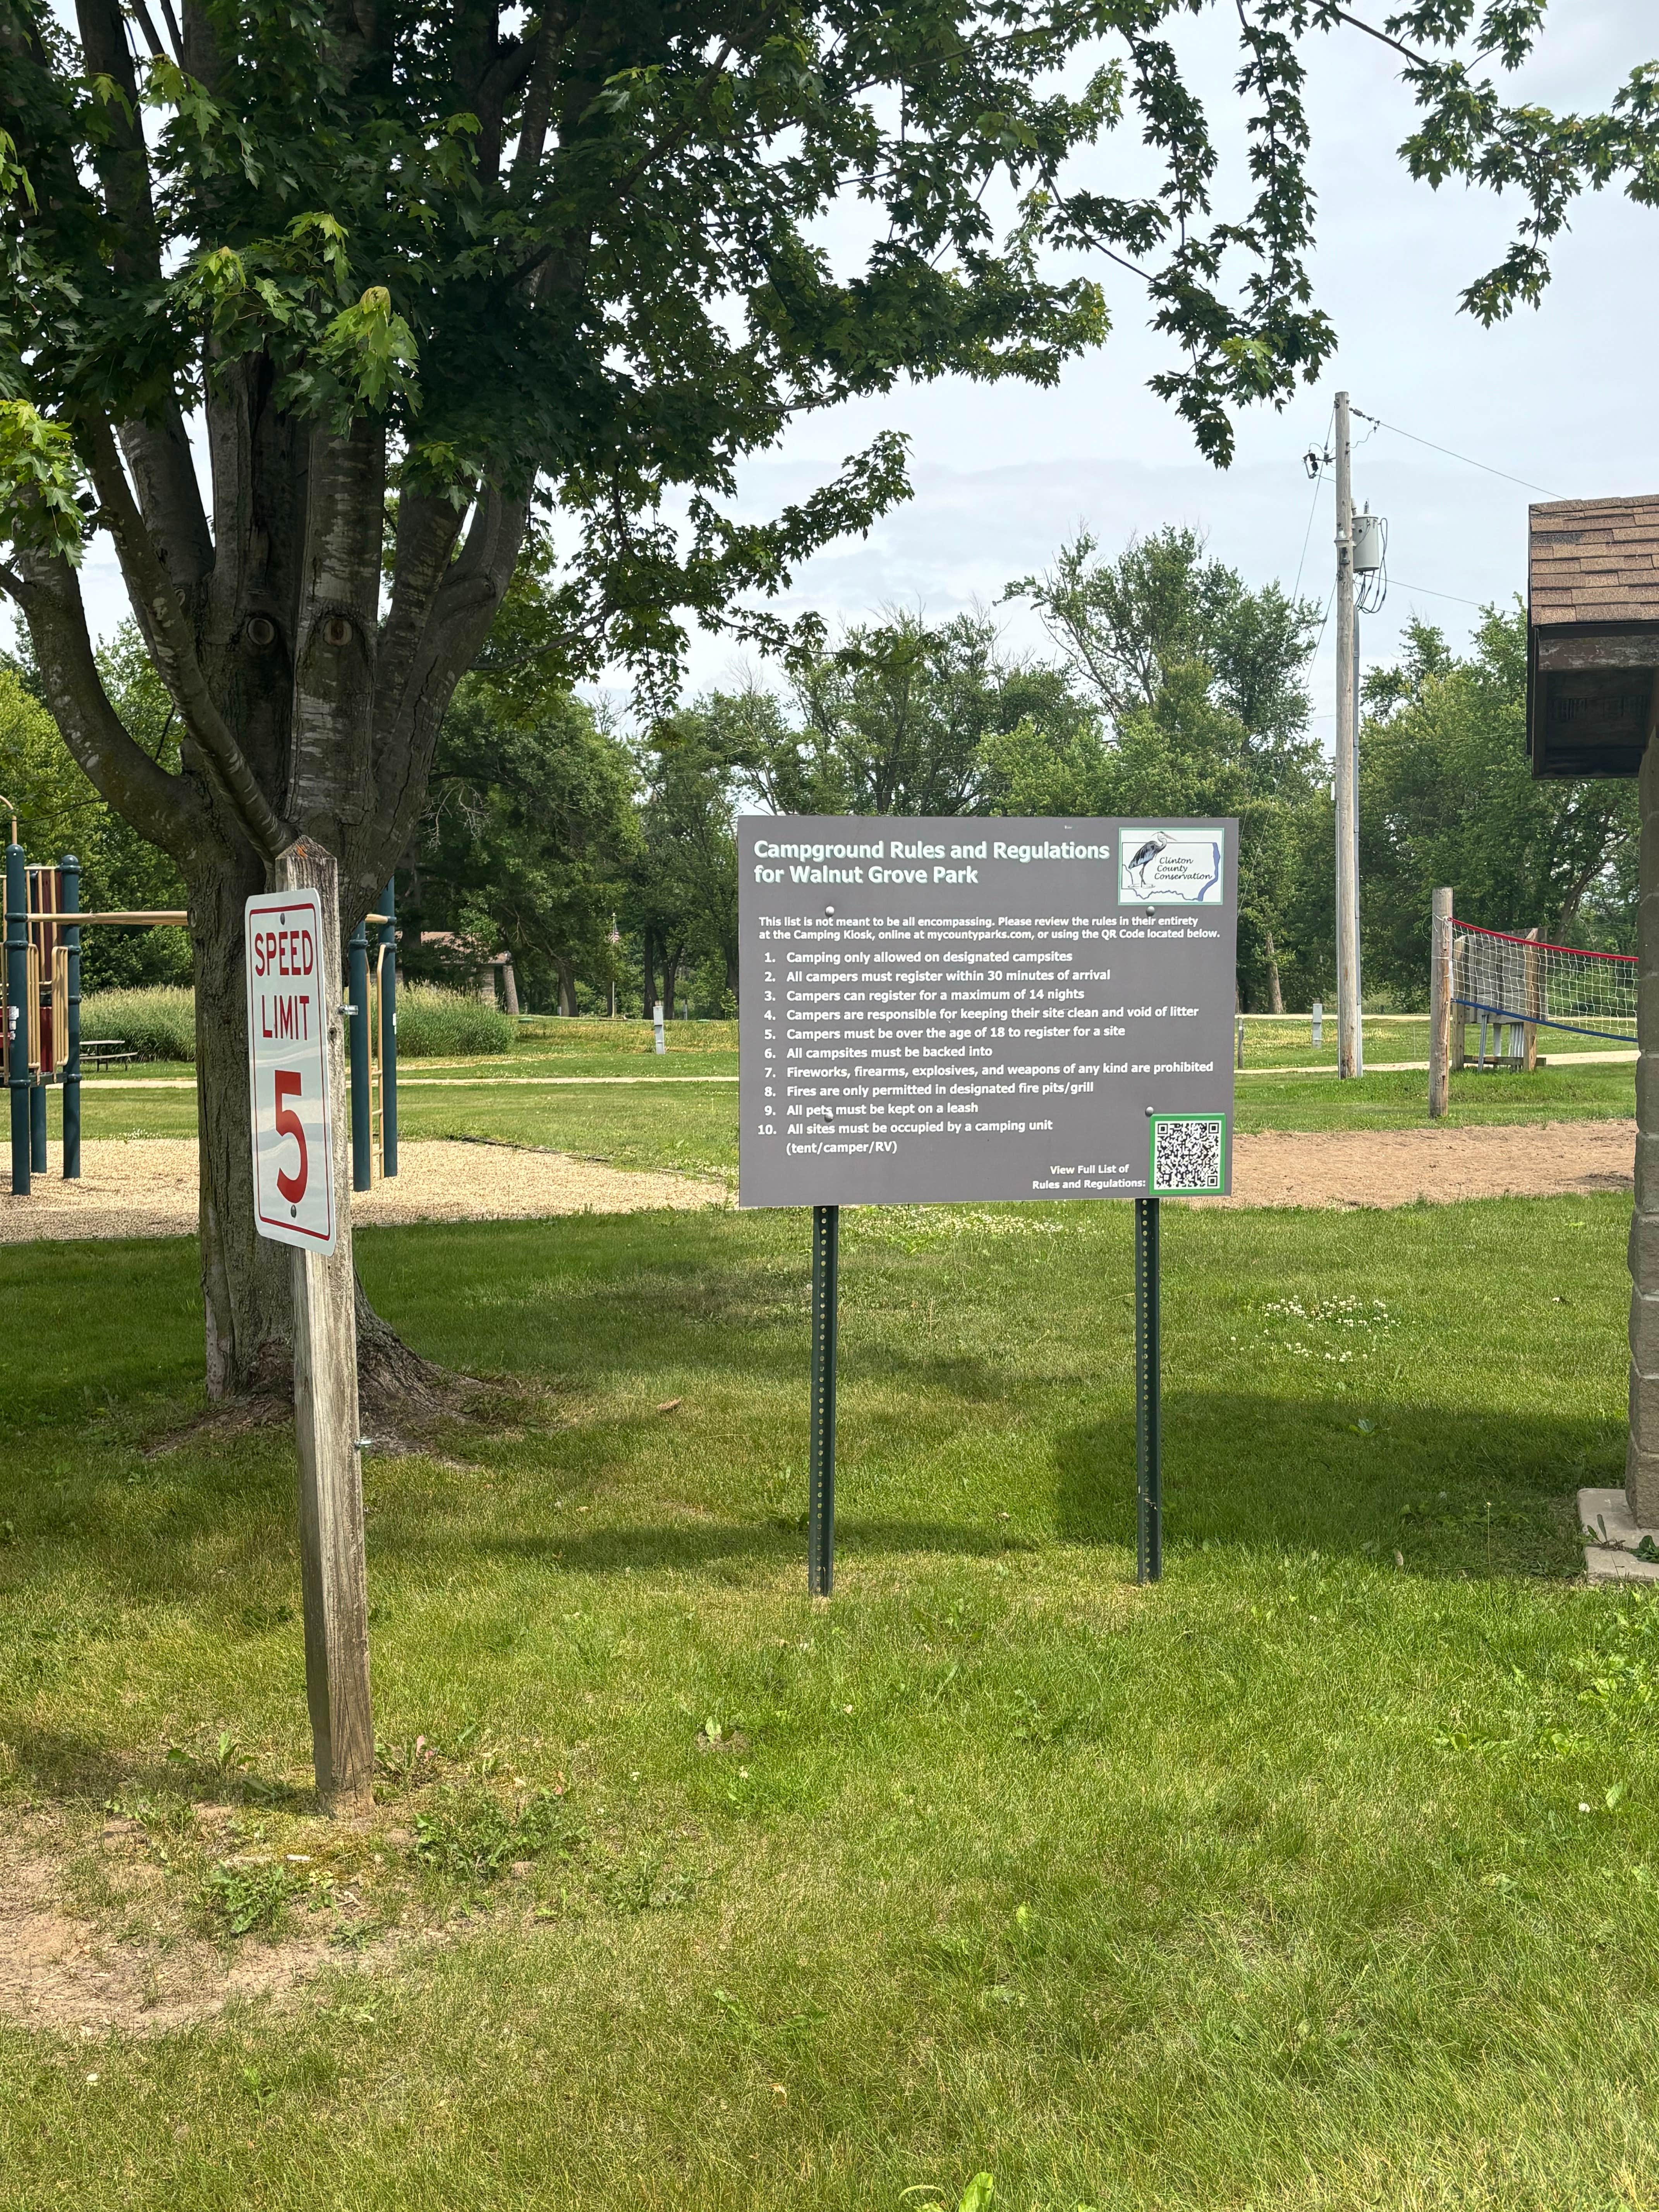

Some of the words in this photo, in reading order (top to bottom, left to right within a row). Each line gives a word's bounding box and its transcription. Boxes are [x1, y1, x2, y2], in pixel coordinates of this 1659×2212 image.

[754, 840, 884, 862] Campground
[890, 840, 945, 859] Rules
[950, 841, 987, 859] and
[993, 841, 1110, 863] Regulations
[754, 864, 785, 883] for
[789, 865, 864, 883] Walnut
[868, 866, 927, 883] Grove
[933, 866, 979, 883] Park
[1157, 865, 1188, 874] County
[758, 916, 781, 926] This
[784, 916, 801, 926] list
[804, 916, 812, 926] is
[815, 917, 834, 926] not
[836, 917, 871, 926] meant
[872, 917, 884, 926] to
[886, 917, 900, 926] be
[902, 916, 915, 926] all
[917, 916, 995, 928] encompassing.
[998, 916, 1032, 926] Please
[1034, 916, 1069, 926] review
[1072, 916, 1089, 926] the
[1092, 916, 1117, 926] rules
[1119, 916, 1129, 926] in
[1131, 916, 1156, 926] their
[1158, 916, 1199, 927] entirety
[759, 930, 771, 939] at
[773, 929, 791, 939] the
[793, 929, 840, 941] Camping
[843, 929, 876, 941] Kiosk,
[878, 929, 911, 939] online
[913, 930, 925, 939] at
[927, 929, 1035, 941] mycountyparks.com,
[1051, 929, 1079, 941] using
[1082, 929, 1099, 939] the
[1101, 929, 1117, 941] QR
[1119, 929, 1145, 938] Code
[1147, 929, 1184, 938] located
[1187, 928, 1220, 938] below.
[255, 930, 313, 976] SPEED
[764, 952, 776, 963] 1.
[786, 951, 841, 965] Camping
[844, 951, 871, 965] only
[873, 951, 921, 962] allowed
[924, 953, 939, 962] on
[943, 951, 1009, 964] designated
[1012, 951, 1073, 964] campsites
[764, 971, 776, 982] 2.
[786, 971, 802, 982] All
[806, 973, 859, 984] campers
[861, 971, 893, 982] must
[895, 970, 943, 984] register
[946, 970, 984, 981] within
[987, 970, 1003, 981] 30
[1006, 970, 1054, 981] minutes
[1057, 969, 1070, 981] of
[1072, 969, 1110, 980] arrival
[764, 990, 776, 1001] 3.
[787, 990, 841, 1003] Campers
[843, 992, 865, 1001] can
[869, 990, 917, 1003] register
[919, 989, 938, 1001] for
[940, 992, 947, 1000] a
[951, 989, 1010, 1000] maximum
[1013, 988, 1027, 1000] of
[1029, 989, 1044, 1000] 14
[1048, 988, 1085, 1001] nights
[262, 996, 309, 1040] LIMIT
[764, 1010, 776, 1020] 4.
[787, 1010, 841, 1022] Campers
[843, 1011, 864, 1020] are
[867, 1008, 937, 1022] responsible
[939, 1008, 958, 1019] for
[960, 1008, 1008, 1021] keeping
[1011, 1007, 1040, 1018] their
[1042, 1007, 1065, 1018] site
[1067, 1006, 1099, 1018] clean
[1102, 1006, 1124, 1017] and
[1127, 1006, 1152, 1017] void
[1154, 1006, 1168, 1017] of
[1170, 1006, 1199, 1017] litter
[764, 1029, 776, 1040] 5.
[787, 1029, 841, 1042] Campers
[844, 1028, 875, 1039] must
[878, 1027, 893, 1039] be
[896, 1030, 924, 1038] over
[926, 1027, 946, 1038] the
[949, 1029, 972, 1040] age
[974, 1027, 988, 1038] of
[990, 1027, 1005, 1037] 18
[1008, 1027, 1021, 1037] to
[1024, 1026, 1071, 1039] register
[1073, 1026, 1091, 1037] for
[1093, 1028, 1101, 1036] a
[1103, 1025, 1125, 1036] site
[764, 1048, 776, 1059] 6.
[787, 1047, 802, 1058] All
[806, 1047, 868, 1060] campsites
[871, 1047, 902, 1058] must
[905, 1046, 920, 1057] be
[923, 1046, 965, 1057] backed
[969, 1046, 993, 1056] into
[764, 1067, 776, 1078] 7.
[787, 1066, 851, 1079] Fireworks,
[854, 1066, 909, 1078] firearms,
[912, 1065, 979, 1078] explosives,
[981, 1064, 1004, 1075] and
[1007, 1066, 1060, 1077] weapons
[1063, 1063, 1076, 1074] of
[1078, 1065, 1100, 1076] any
[1103, 1062, 1128, 1073] kind
[1131, 1064, 1151, 1073] are
[1153, 1061, 1213, 1075] prohibited
[764, 1086, 776, 1097] 8.
[787, 1085, 817, 1096] Fires
[819, 1087, 840, 1096] are
[843, 1085, 869, 1098] only
[872, 1084, 932, 1097] permitted
[935, 1084, 946, 1094] in
[950, 1082, 1015, 1096] designated
[1018, 1082, 1039, 1093] fire
[1042, 1081, 1094, 1095] pits/grill
[764, 1105, 776, 1116] 9.
[787, 1104, 802, 1115] All
[806, 1105, 833, 1118] pets
[836, 1104, 867, 1115] must
[870, 1103, 884, 1114] be
[888, 1103, 915, 1116] kept
[917, 1105, 933, 1114] on
[936, 1105, 943, 1113] a
[947, 1102, 978, 1113] leash
[758, 1124, 777, 1135] 10.
[787, 1123, 803, 1134] All
[806, 1123, 835, 1134] sites
[838, 1123, 869, 1133] must
[872, 1122, 887, 1133] be
[890, 1121, 944, 1135] occupied
[947, 1121, 962, 1134] by
[964, 1123, 972, 1132] a
[975, 1120, 1025, 1133] camping
[1029, 1119, 1053, 1130] unit
[275, 1070, 308, 1204] 5
[786, 1140, 897, 1156] (tent/camper/RV)
[1050, 1165, 1075, 1175] View
[1077, 1164, 1096, 1174] Full
[1098, 1164, 1117, 1173] List
[1118, 1164, 1130, 1173] of
[1032, 1180, 1060, 1189] Rules
[1062, 1179, 1081, 1188] and
[1084, 1178, 1146, 1190] Regulations:
